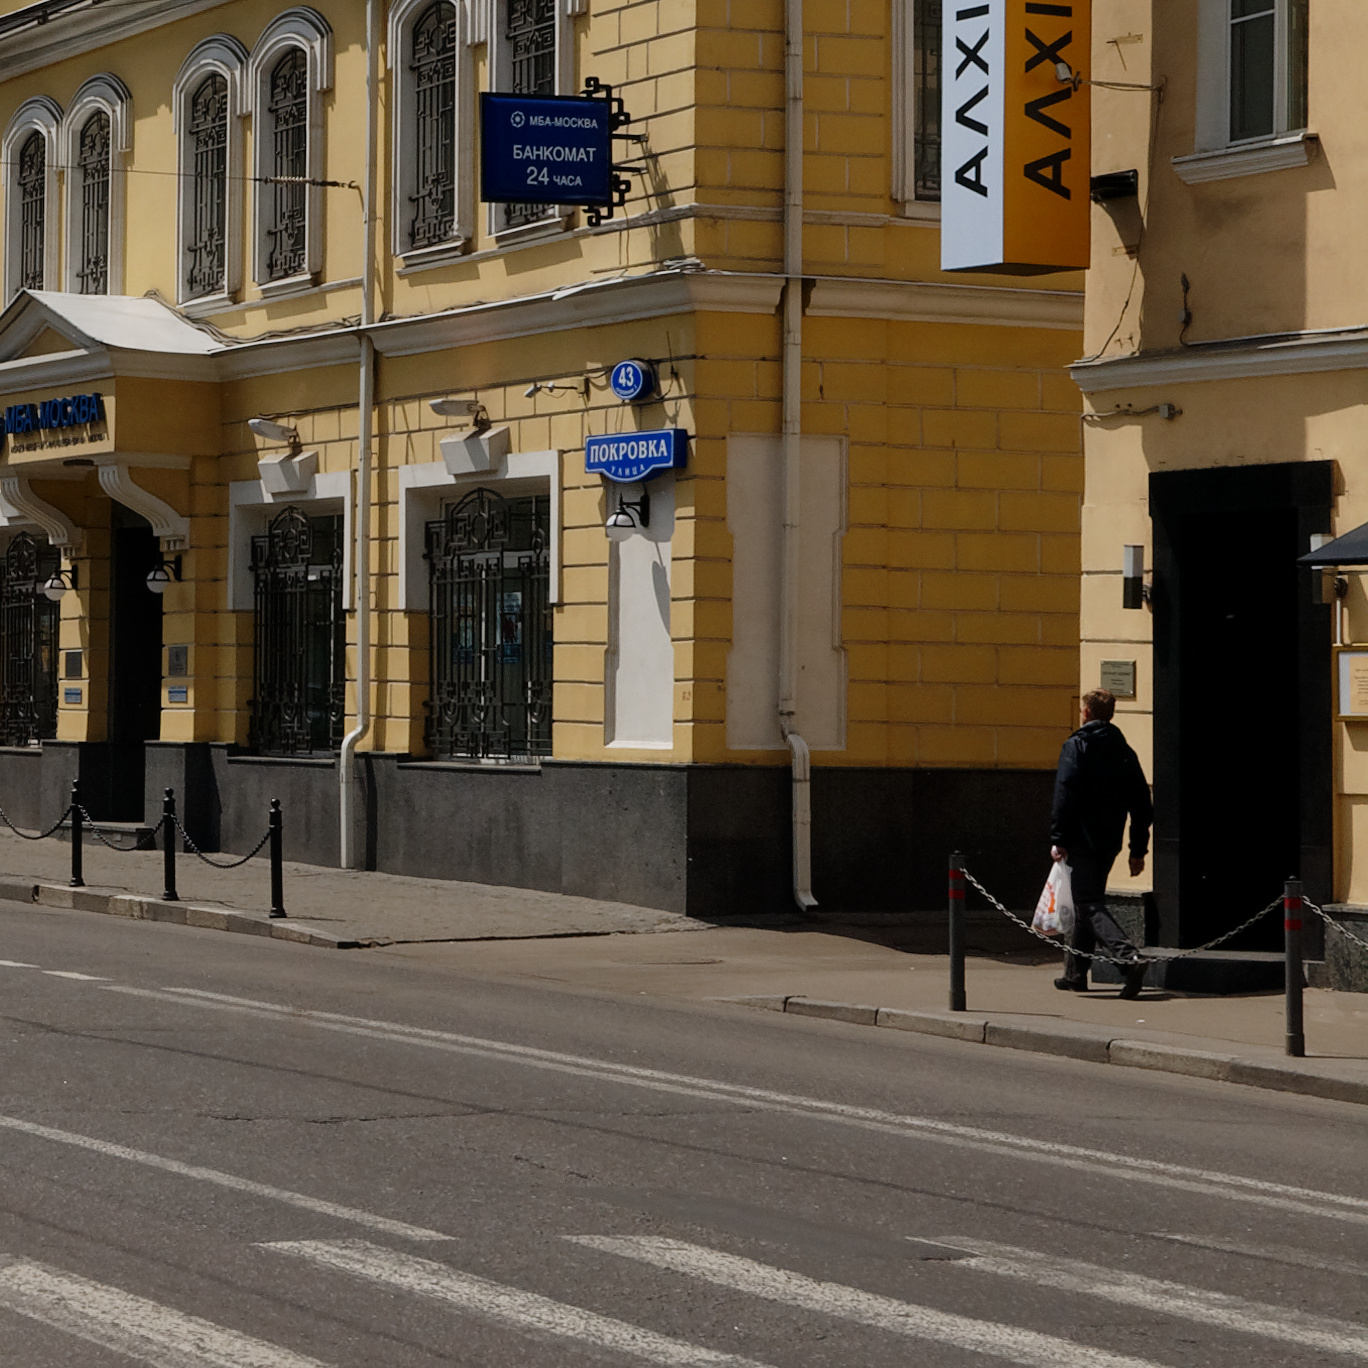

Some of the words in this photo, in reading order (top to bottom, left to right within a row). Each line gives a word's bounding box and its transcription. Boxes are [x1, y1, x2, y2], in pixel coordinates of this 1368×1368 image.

[529, 115, 599, 129] МБА-МОСКВА
[512, 144, 597, 162] БАНКОМАТ
[526, 166, 550, 185] 24
[553, 174, 583, 187] ЧАСА
[618, 366, 634, 387] 43
[590, 439, 668, 463] ПОКРОВКА
[610, 464, 646, 476] УЛИЦА
